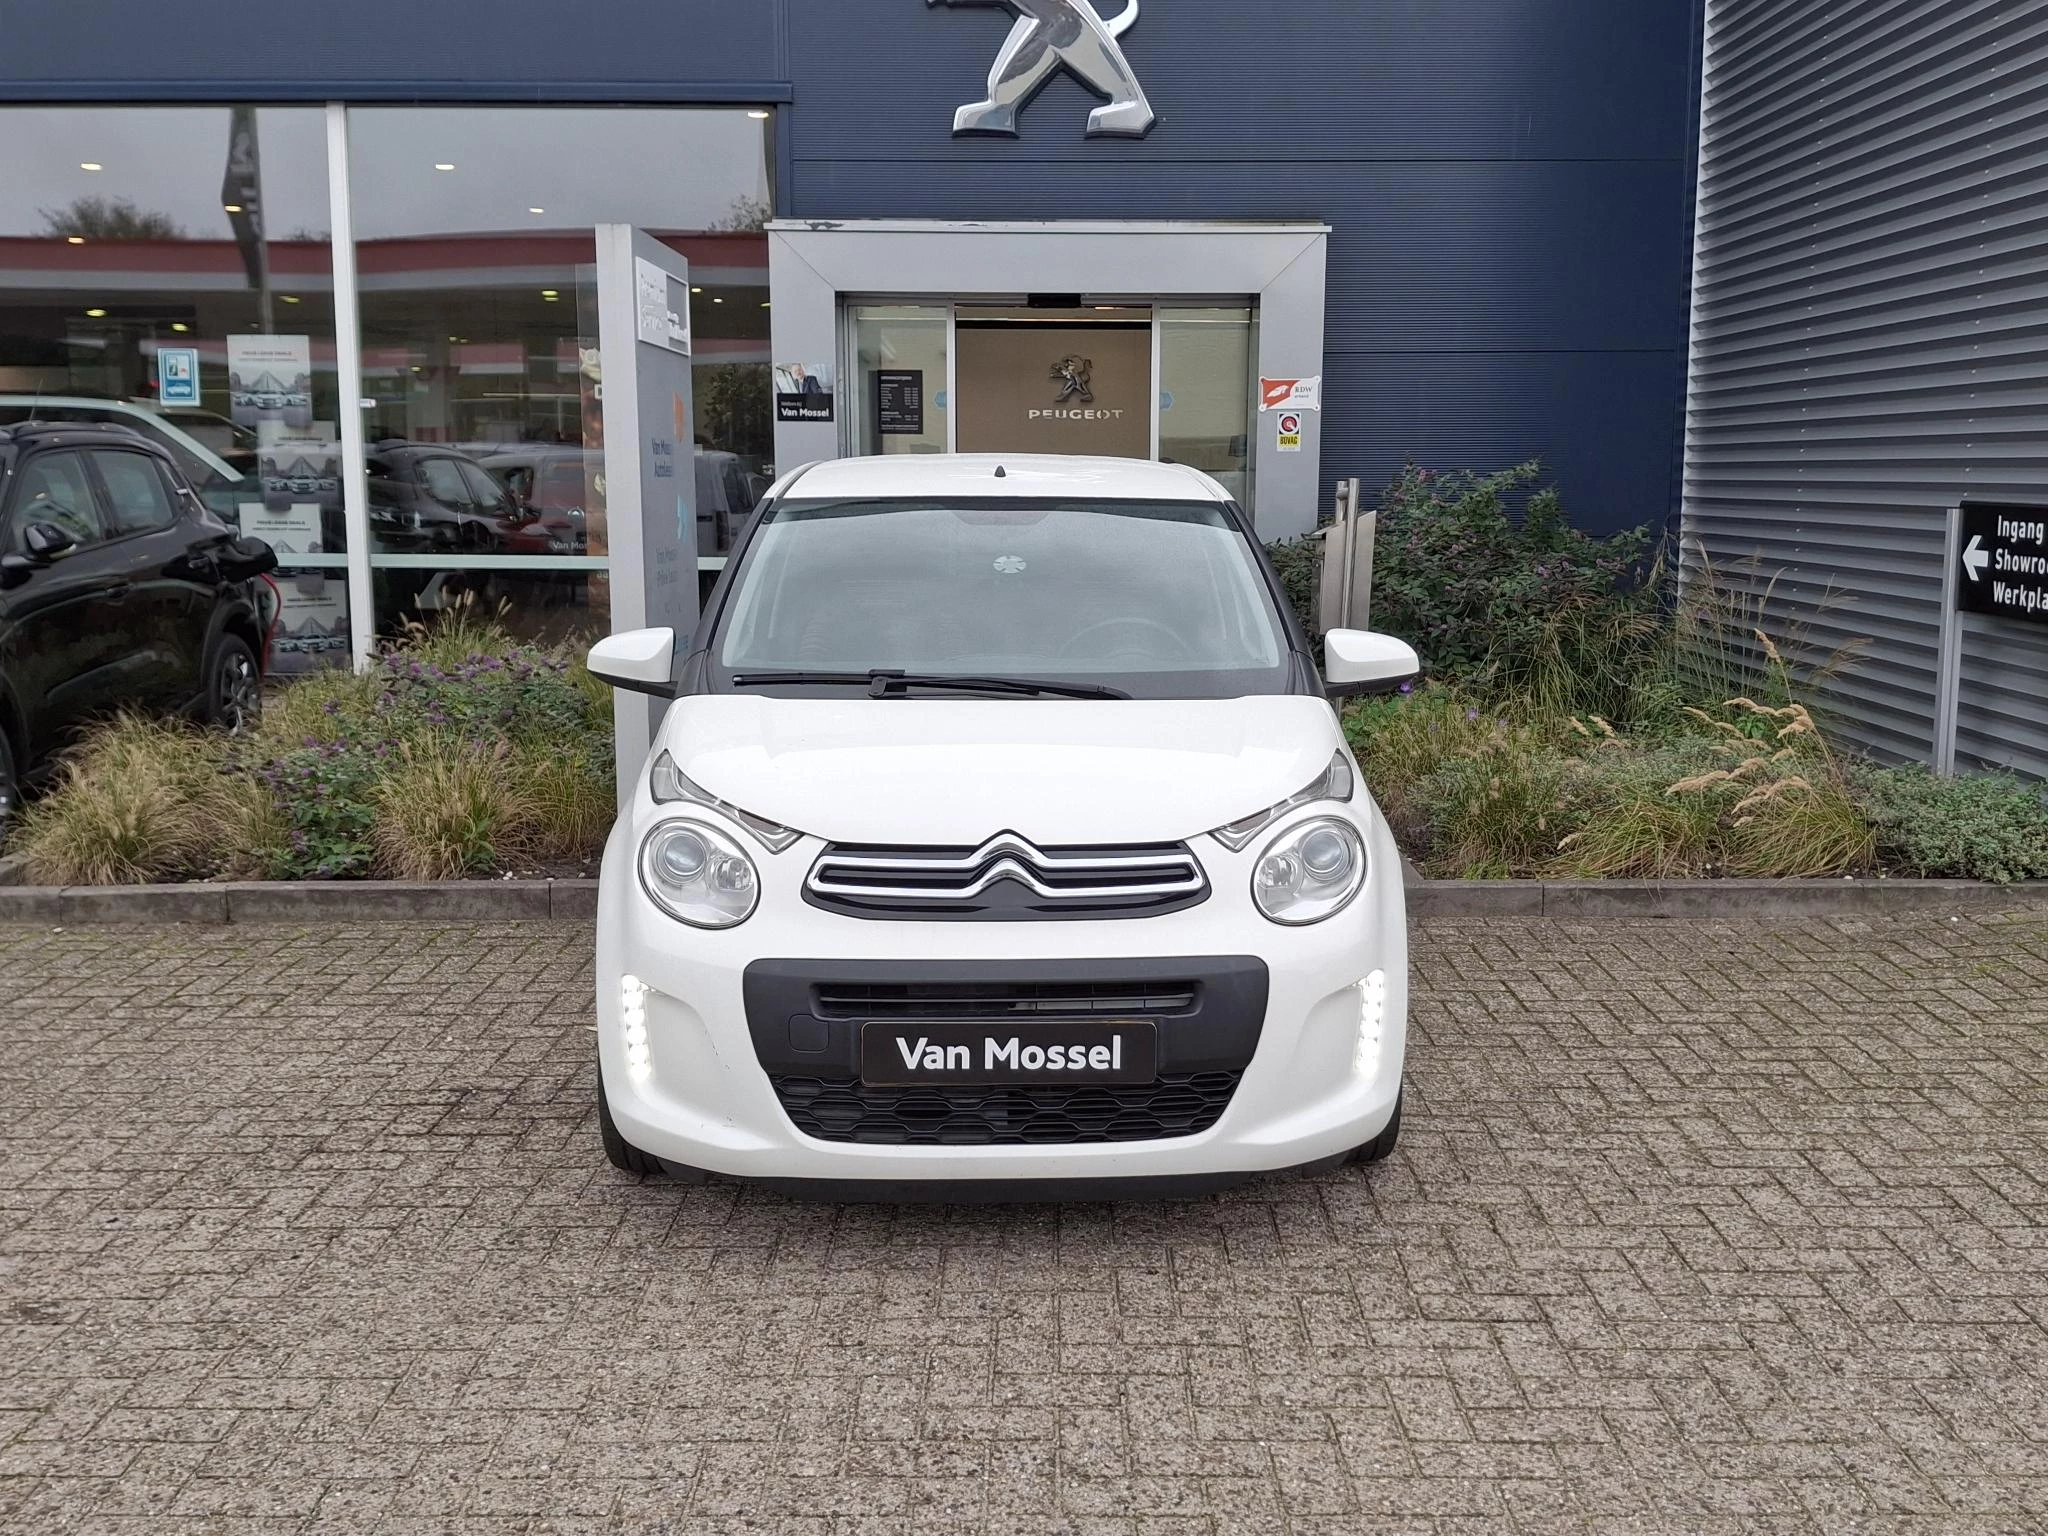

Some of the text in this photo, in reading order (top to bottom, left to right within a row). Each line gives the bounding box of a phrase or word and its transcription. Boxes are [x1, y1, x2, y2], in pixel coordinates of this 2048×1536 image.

[781, 407, 829, 417] Van Mossel
[1028, 409, 1124, 420] PEUGEOT
[1997, 515, 2044, 545] Ingang
[1994, 548, 2048, 575] Showro
[1993, 581, 2048, 613] Werkpla
[896, 1035, 1121, 1070] Van Mossel
